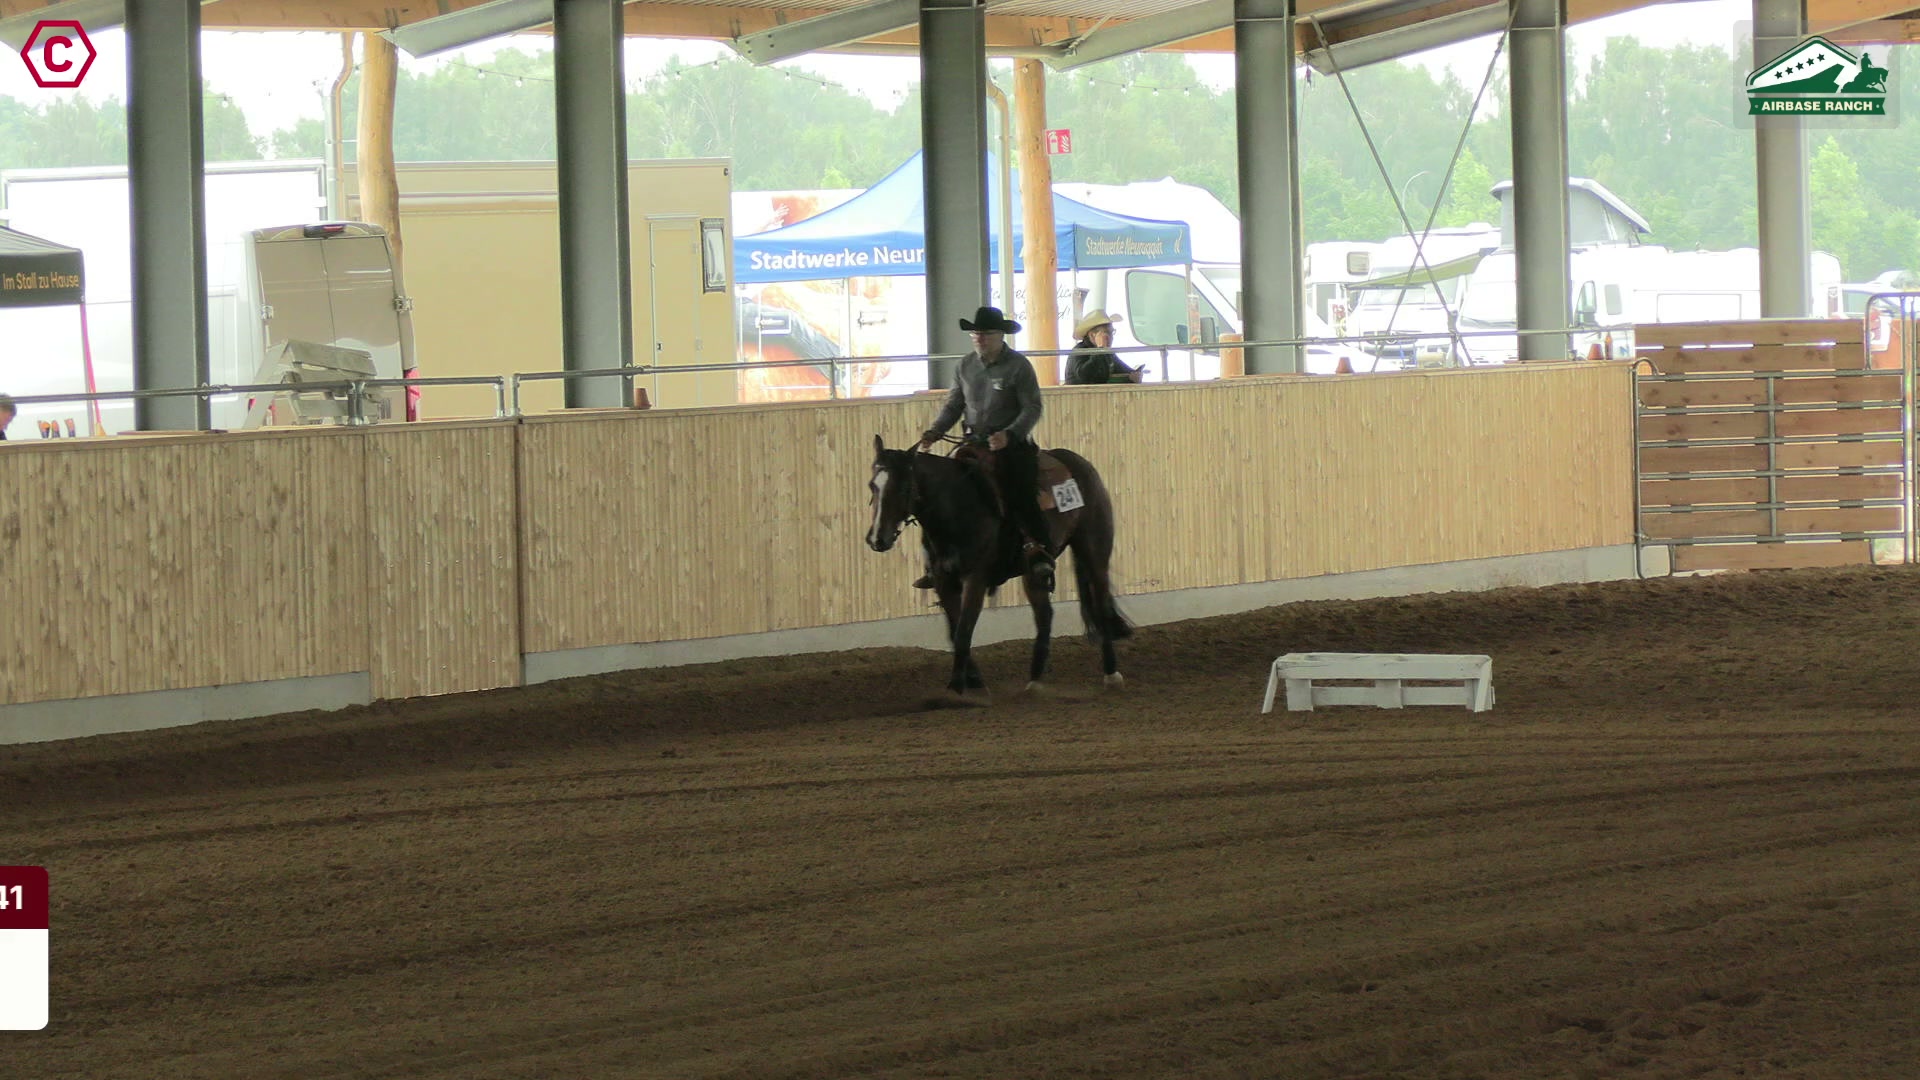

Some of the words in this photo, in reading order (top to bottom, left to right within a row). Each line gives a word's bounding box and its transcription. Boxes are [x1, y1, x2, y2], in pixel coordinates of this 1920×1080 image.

[1085, 236, 1124, 256] Stadtwerke
[750, 247, 869, 270] Stadtwerke
[16, 271, 37, 290] Stall
[38, 275, 50, 289] zu
[50, 271, 80, 289] Hause
